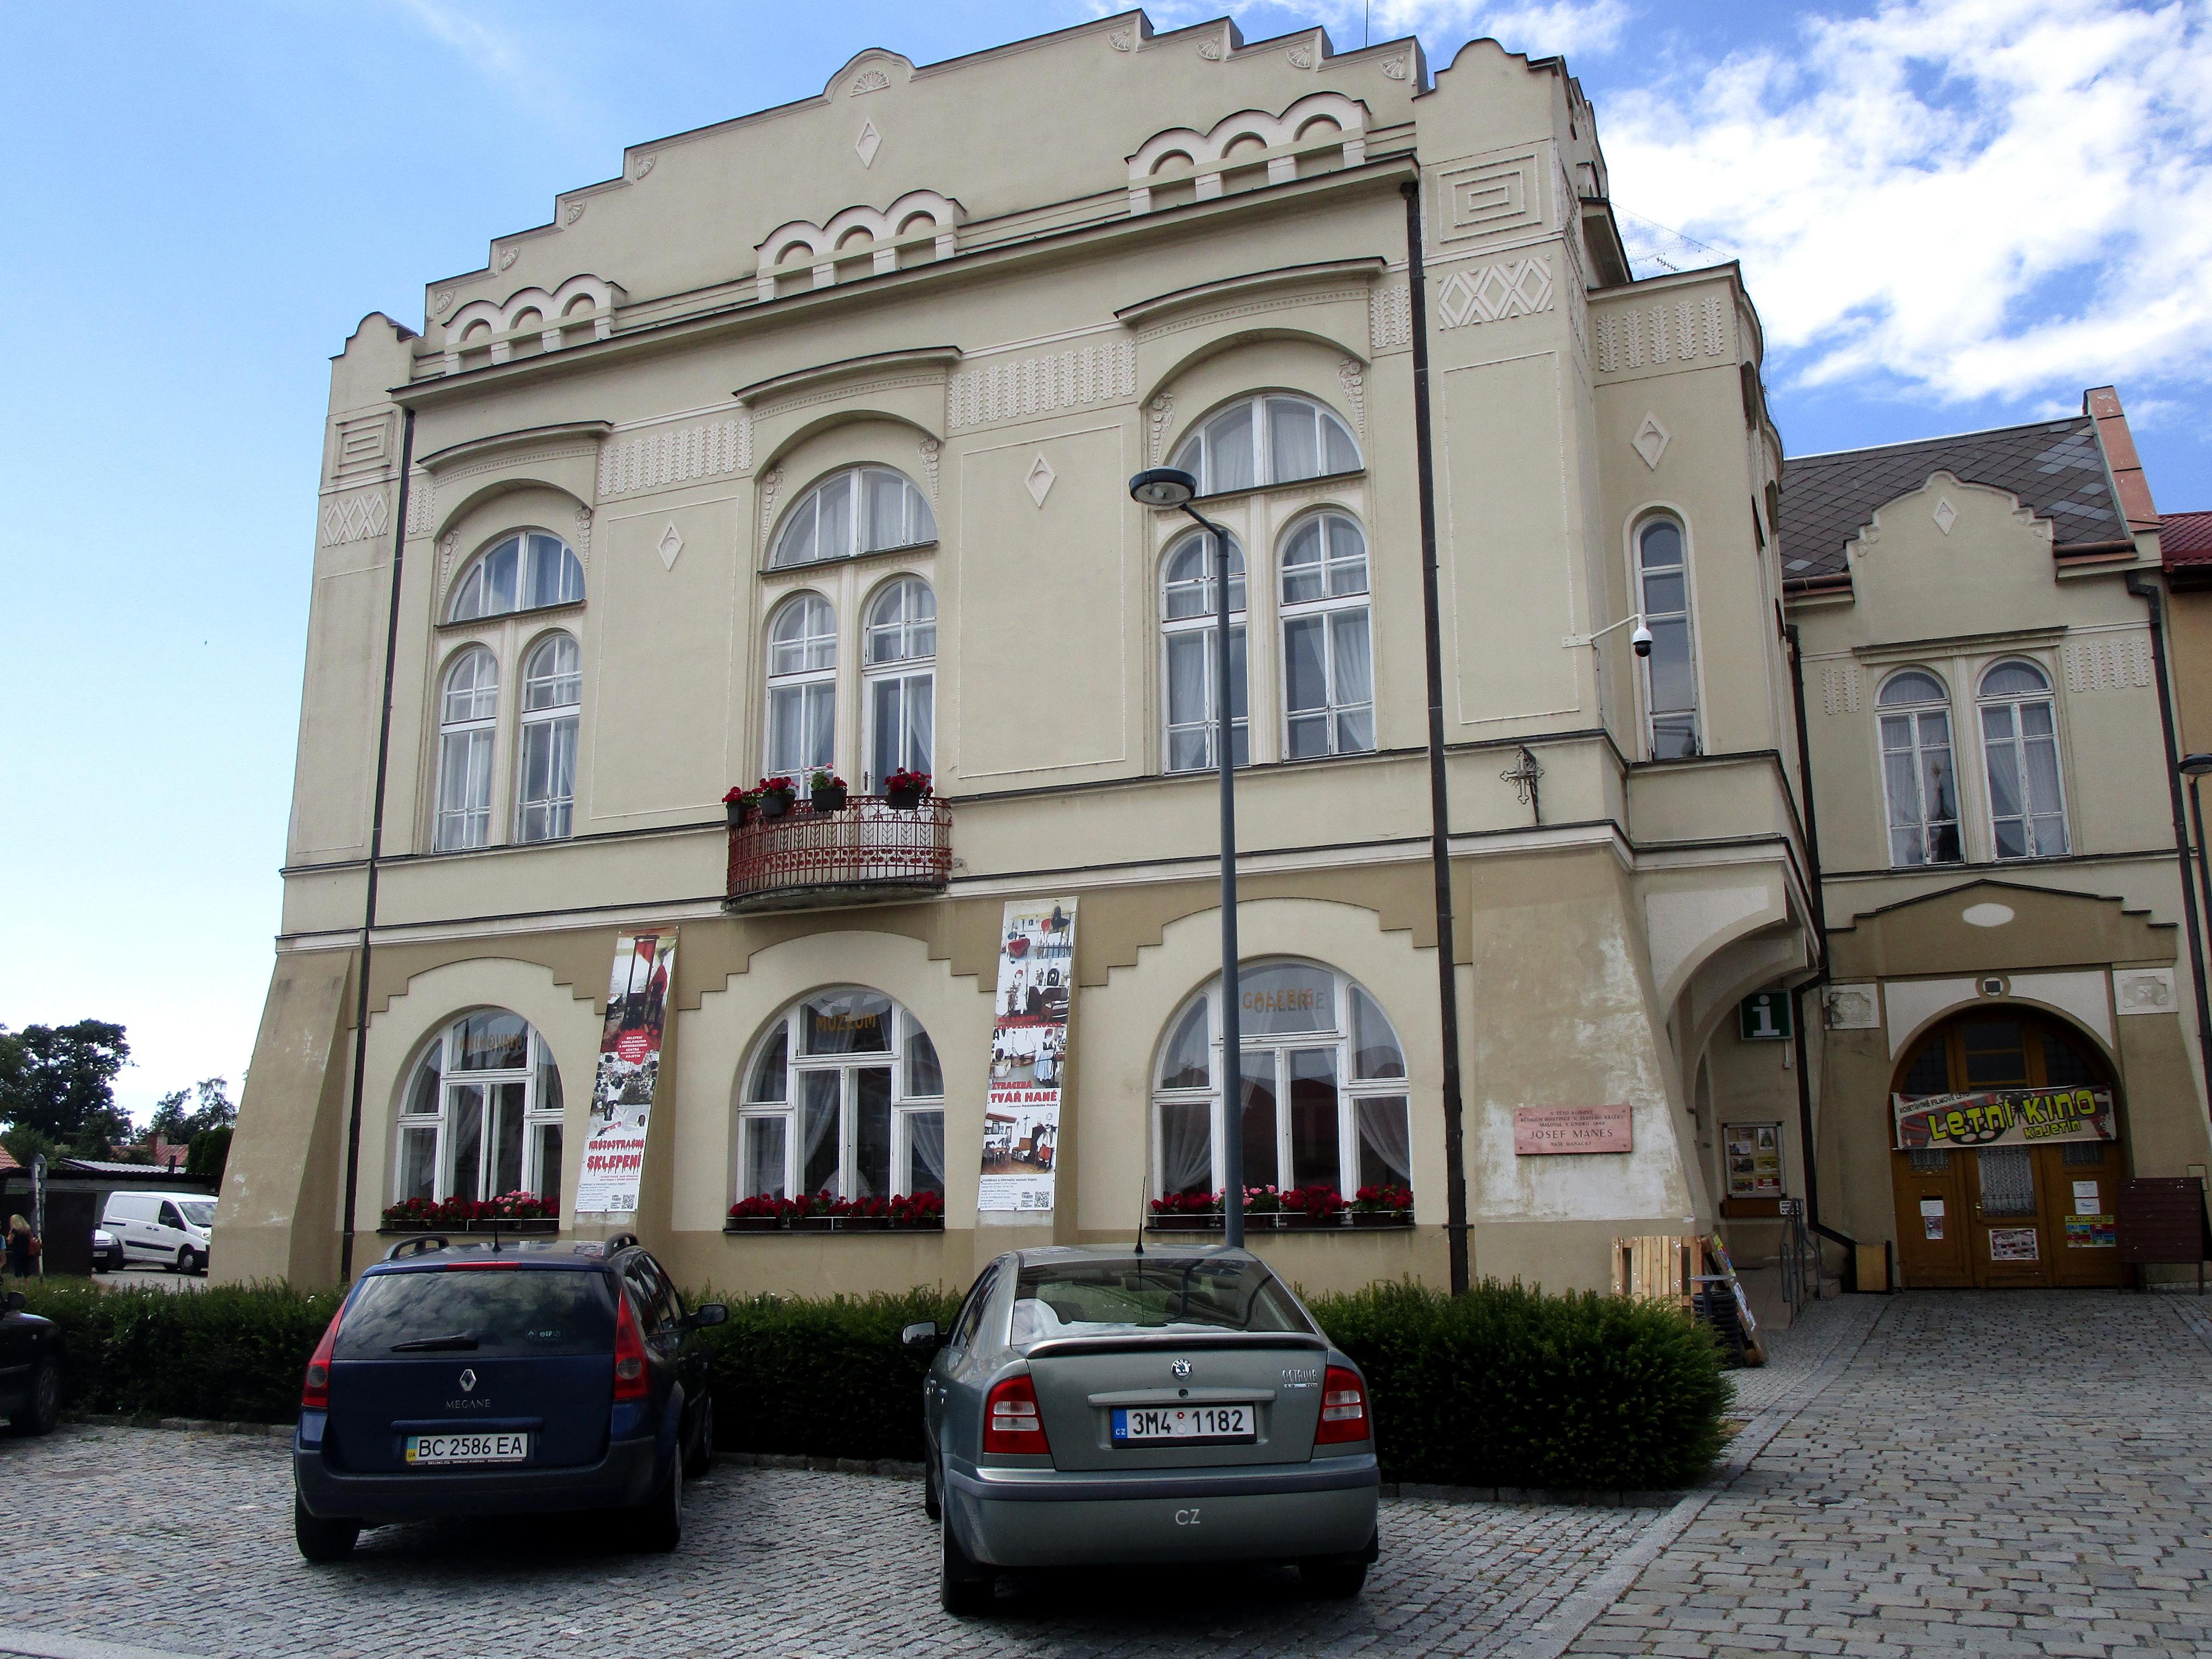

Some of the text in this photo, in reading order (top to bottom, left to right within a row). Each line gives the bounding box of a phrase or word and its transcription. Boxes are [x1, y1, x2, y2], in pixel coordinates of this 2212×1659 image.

[1243, 988, 1313, 1009] GALERIE
[990, 1089, 1057, 1103] TVÁŘ HANÉ
[1530, 1129, 1566, 1139] JOSEF
[587, 1151, 642, 1174] SKLEPENÍ
[1282, 1369, 1317, 1382] OCTAVIA
[446, 1399, 491, 1408] MEGANE
[1133, 1412, 1171, 1434] 3M4
[1192, 1410, 1244, 1433] 1182
[419, 1439, 445, 1457] BC
[450, 1437, 492, 1455] 2586
[497, 1437, 523, 1454] EA
[1175, 1509, 1201, 1525] CZ
